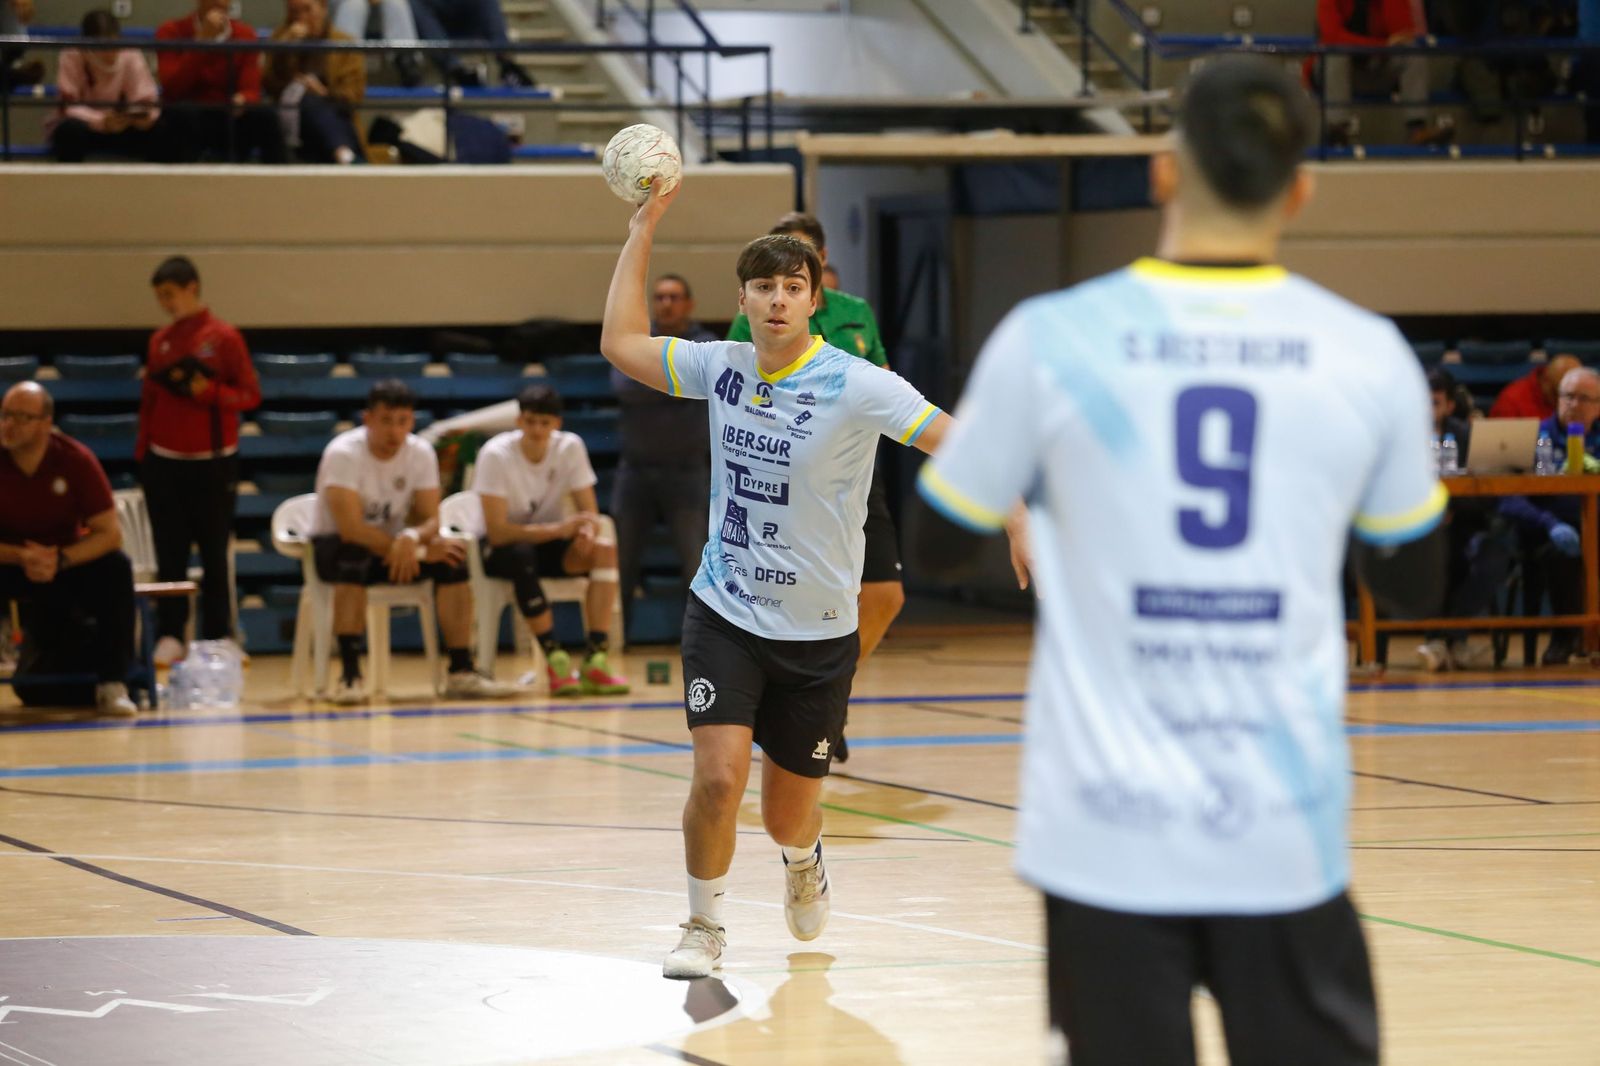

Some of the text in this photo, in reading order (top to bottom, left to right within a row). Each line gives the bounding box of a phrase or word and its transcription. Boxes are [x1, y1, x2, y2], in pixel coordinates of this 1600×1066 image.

[714, 367, 745, 406] 46
[786, 424, 813, 436] Domino's
[790, 433, 806, 441] Pizza
[722, 424, 791, 458] IBERSUR
[1174, 383, 1258, 550] 9
[743, 477, 779, 494] DYPRE
[755, 566, 797, 586] DFDS
